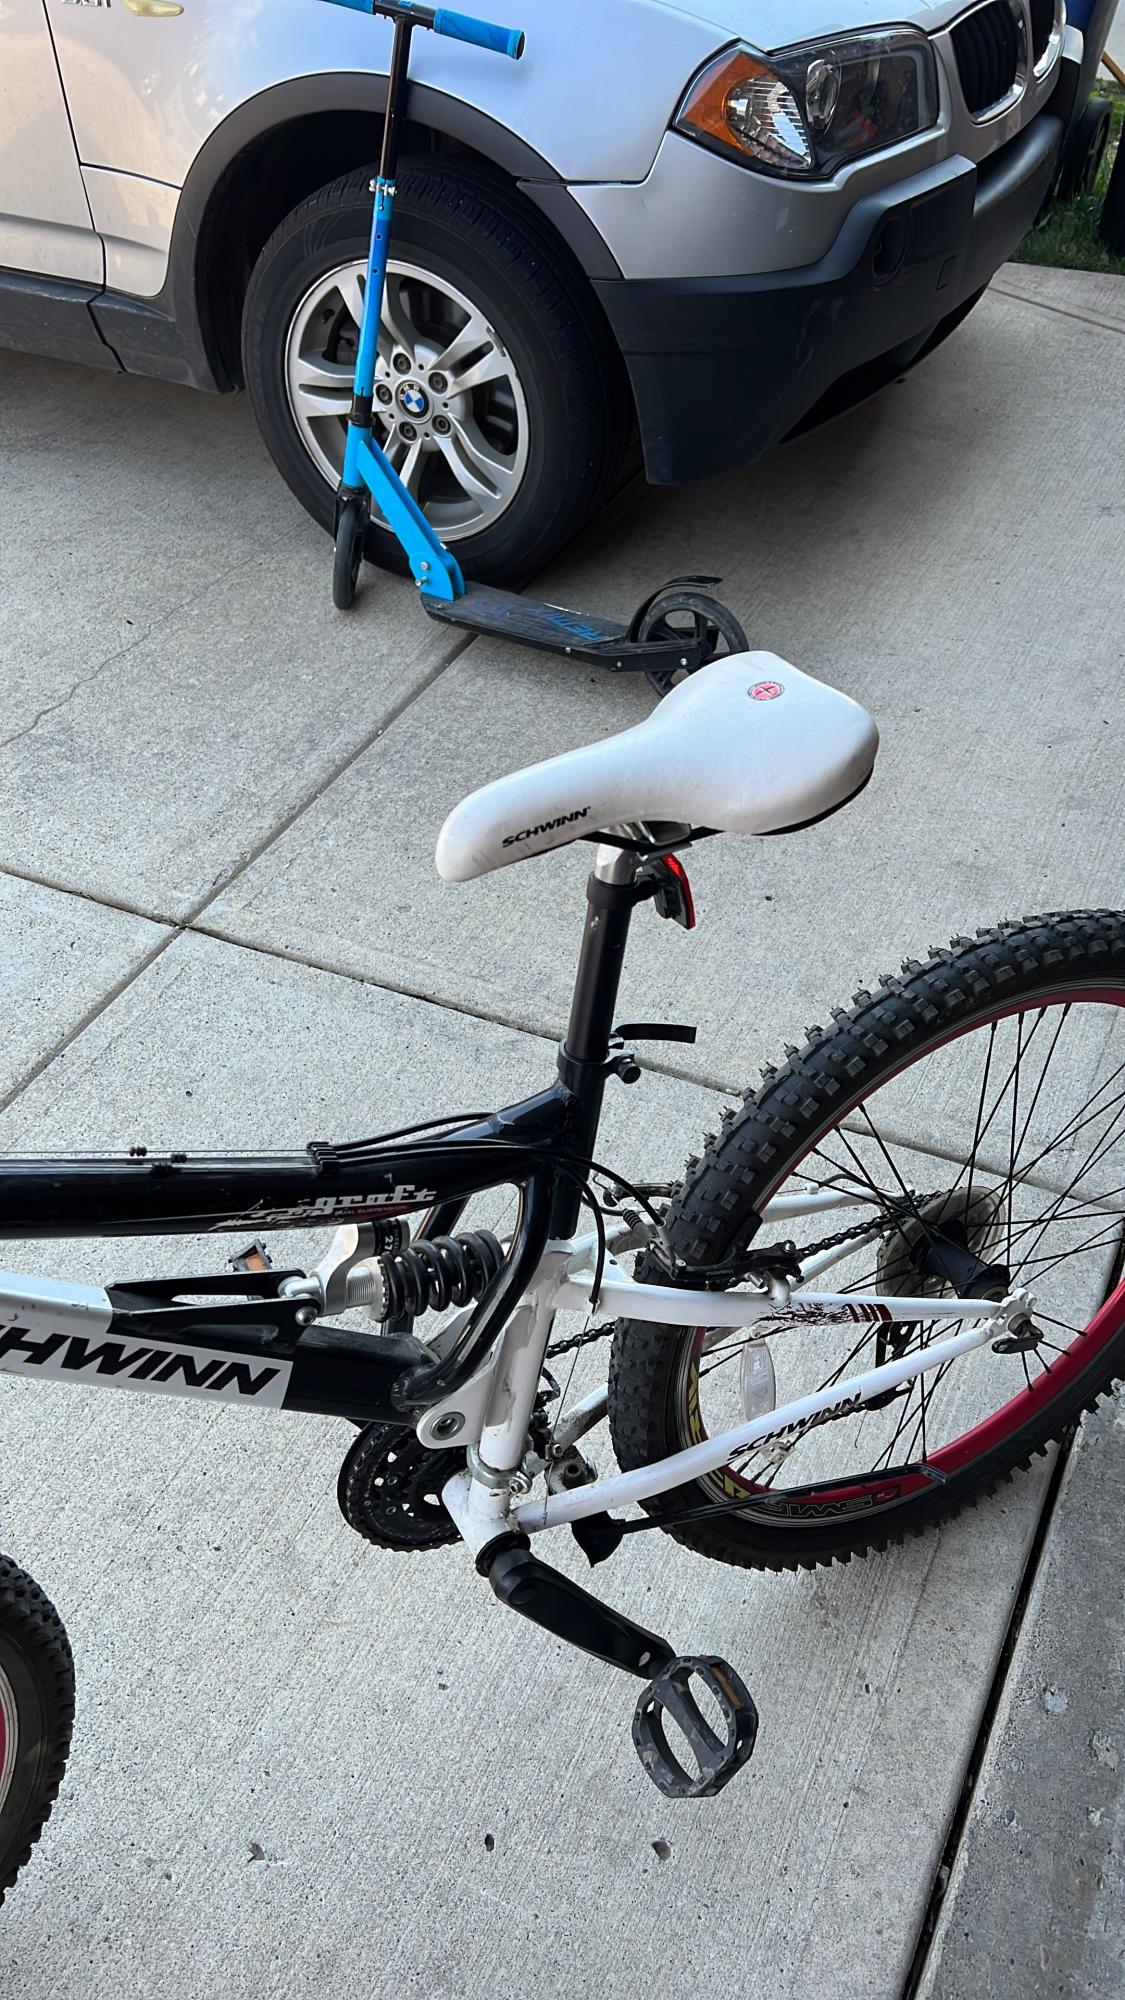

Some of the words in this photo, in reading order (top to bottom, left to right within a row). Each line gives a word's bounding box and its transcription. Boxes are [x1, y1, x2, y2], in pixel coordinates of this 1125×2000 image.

[502, 806, 590, 848] SCHWINN
[0, 1325, 280, 1396] HWINN
[727, 1391, 862, 1461] SCHWINN
